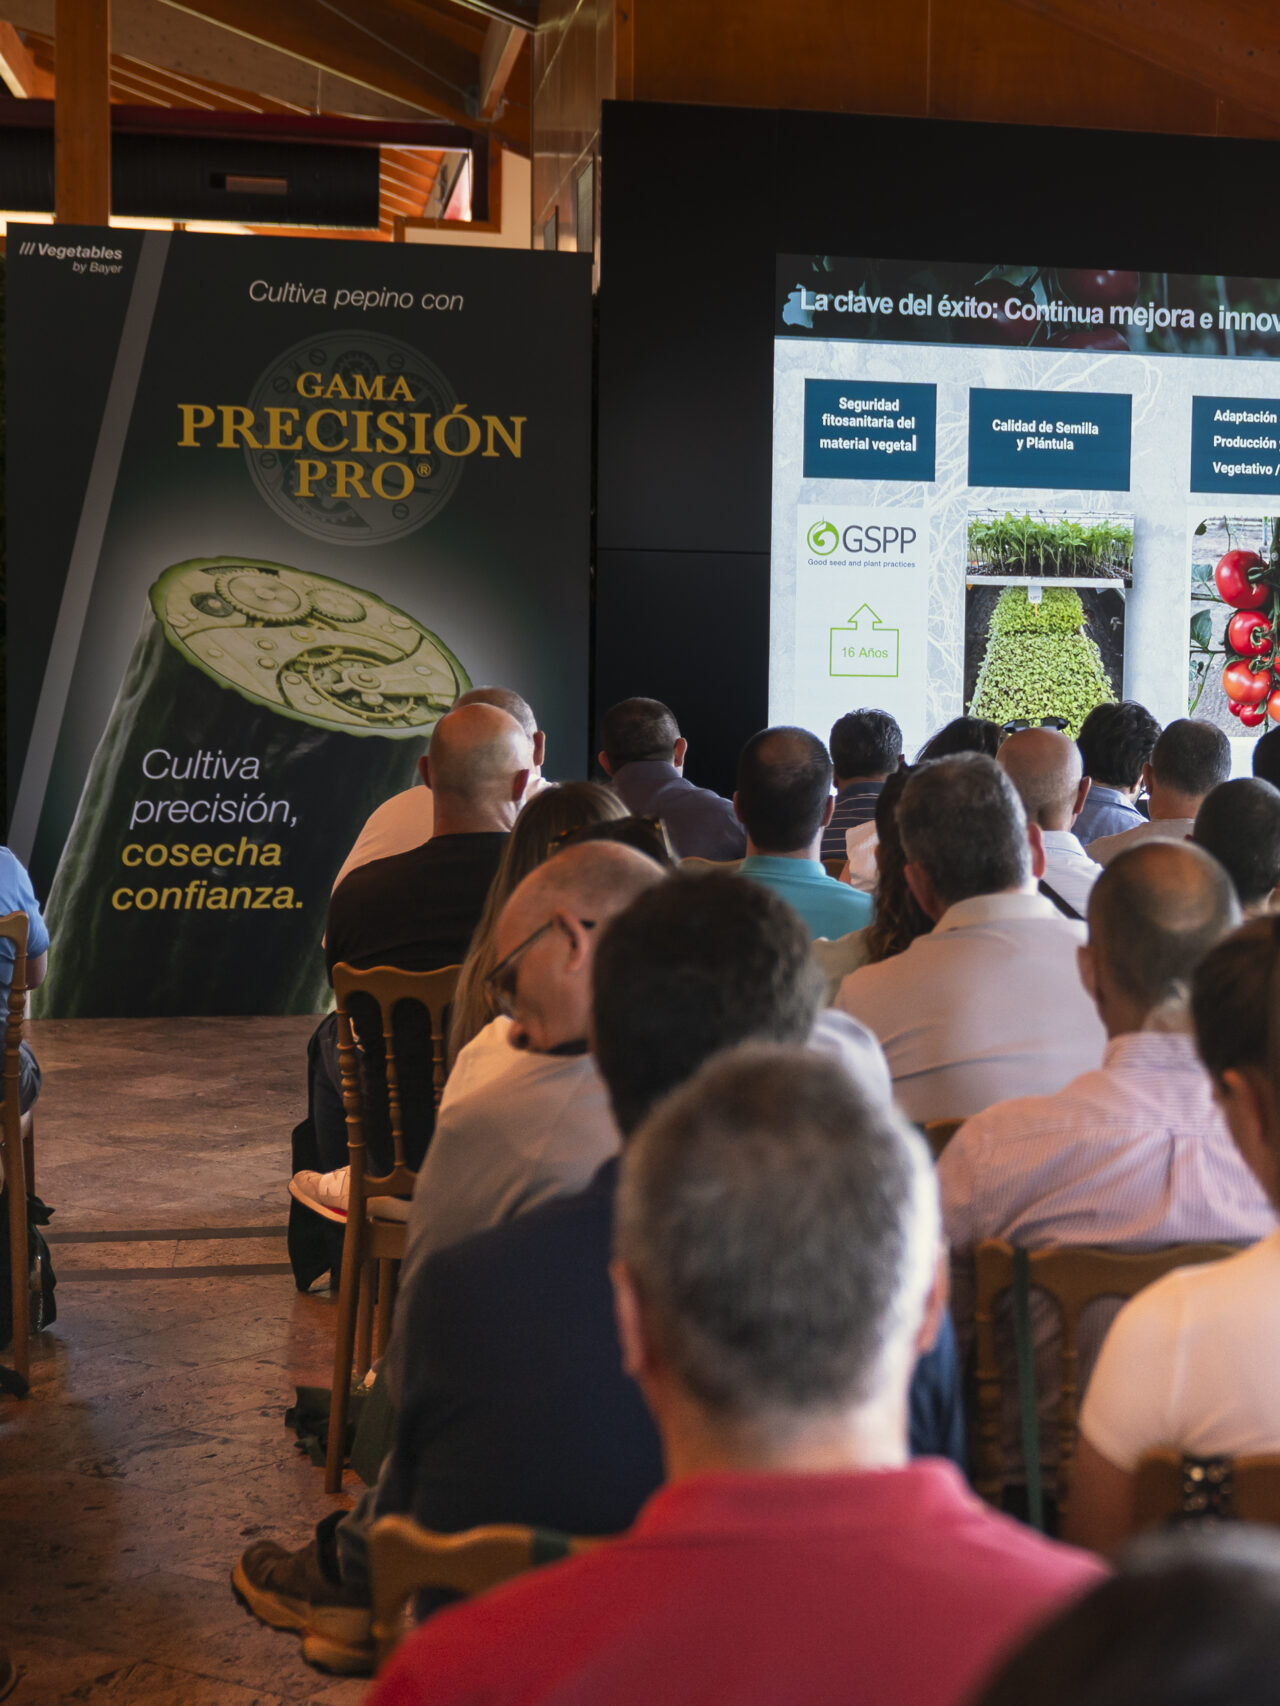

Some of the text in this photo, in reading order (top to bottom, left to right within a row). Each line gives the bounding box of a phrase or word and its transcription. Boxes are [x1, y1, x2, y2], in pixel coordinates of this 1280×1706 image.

[38, 243, 122, 260] Vegetables
[72, 261, 122, 275] by Bayer
[248, 280, 464, 311] Cultiva pepino con
[800, 288, 828, 312] La
[834, 290, 894, 316] clave
[899, 293, 932, 317] del
[937, 295, 998, 320] éxito:
[1004, 298, 1104, 324] Continua
[1110, 302, 1195, 333] mejora
[1200, 312, 1213, 330] e
[296, 371, 416, 403] GAMA
[839, 397, 900, 413] Seguridad
[822, 413, 915, 429] fitosanitaria del
[1213, 409, 1277, 425] Adaptación
[177, 403, 527, 458] PRECISIÓN
[992, 419, 1099, 435] Calidad de Semilla
[819, 434, 917, 454] material vegetal
[1016, 437, 1074, 451] y Plántula
[1213, 435, 1276, 449] Producción
[1212, 461, 1273, 477] Vegetativo
[842, 525, 917, 554] GSPP
[808, 558, 916, 569] Good seed and plant practices
[841, 645, 889, 659] 16 Años
[142, 749, 261, 780] Cultiva
[129, 793, 299, 831] precisión,
[121, 837, 282, 867] cosecha
[111, 880, 304, 911] confianza.
